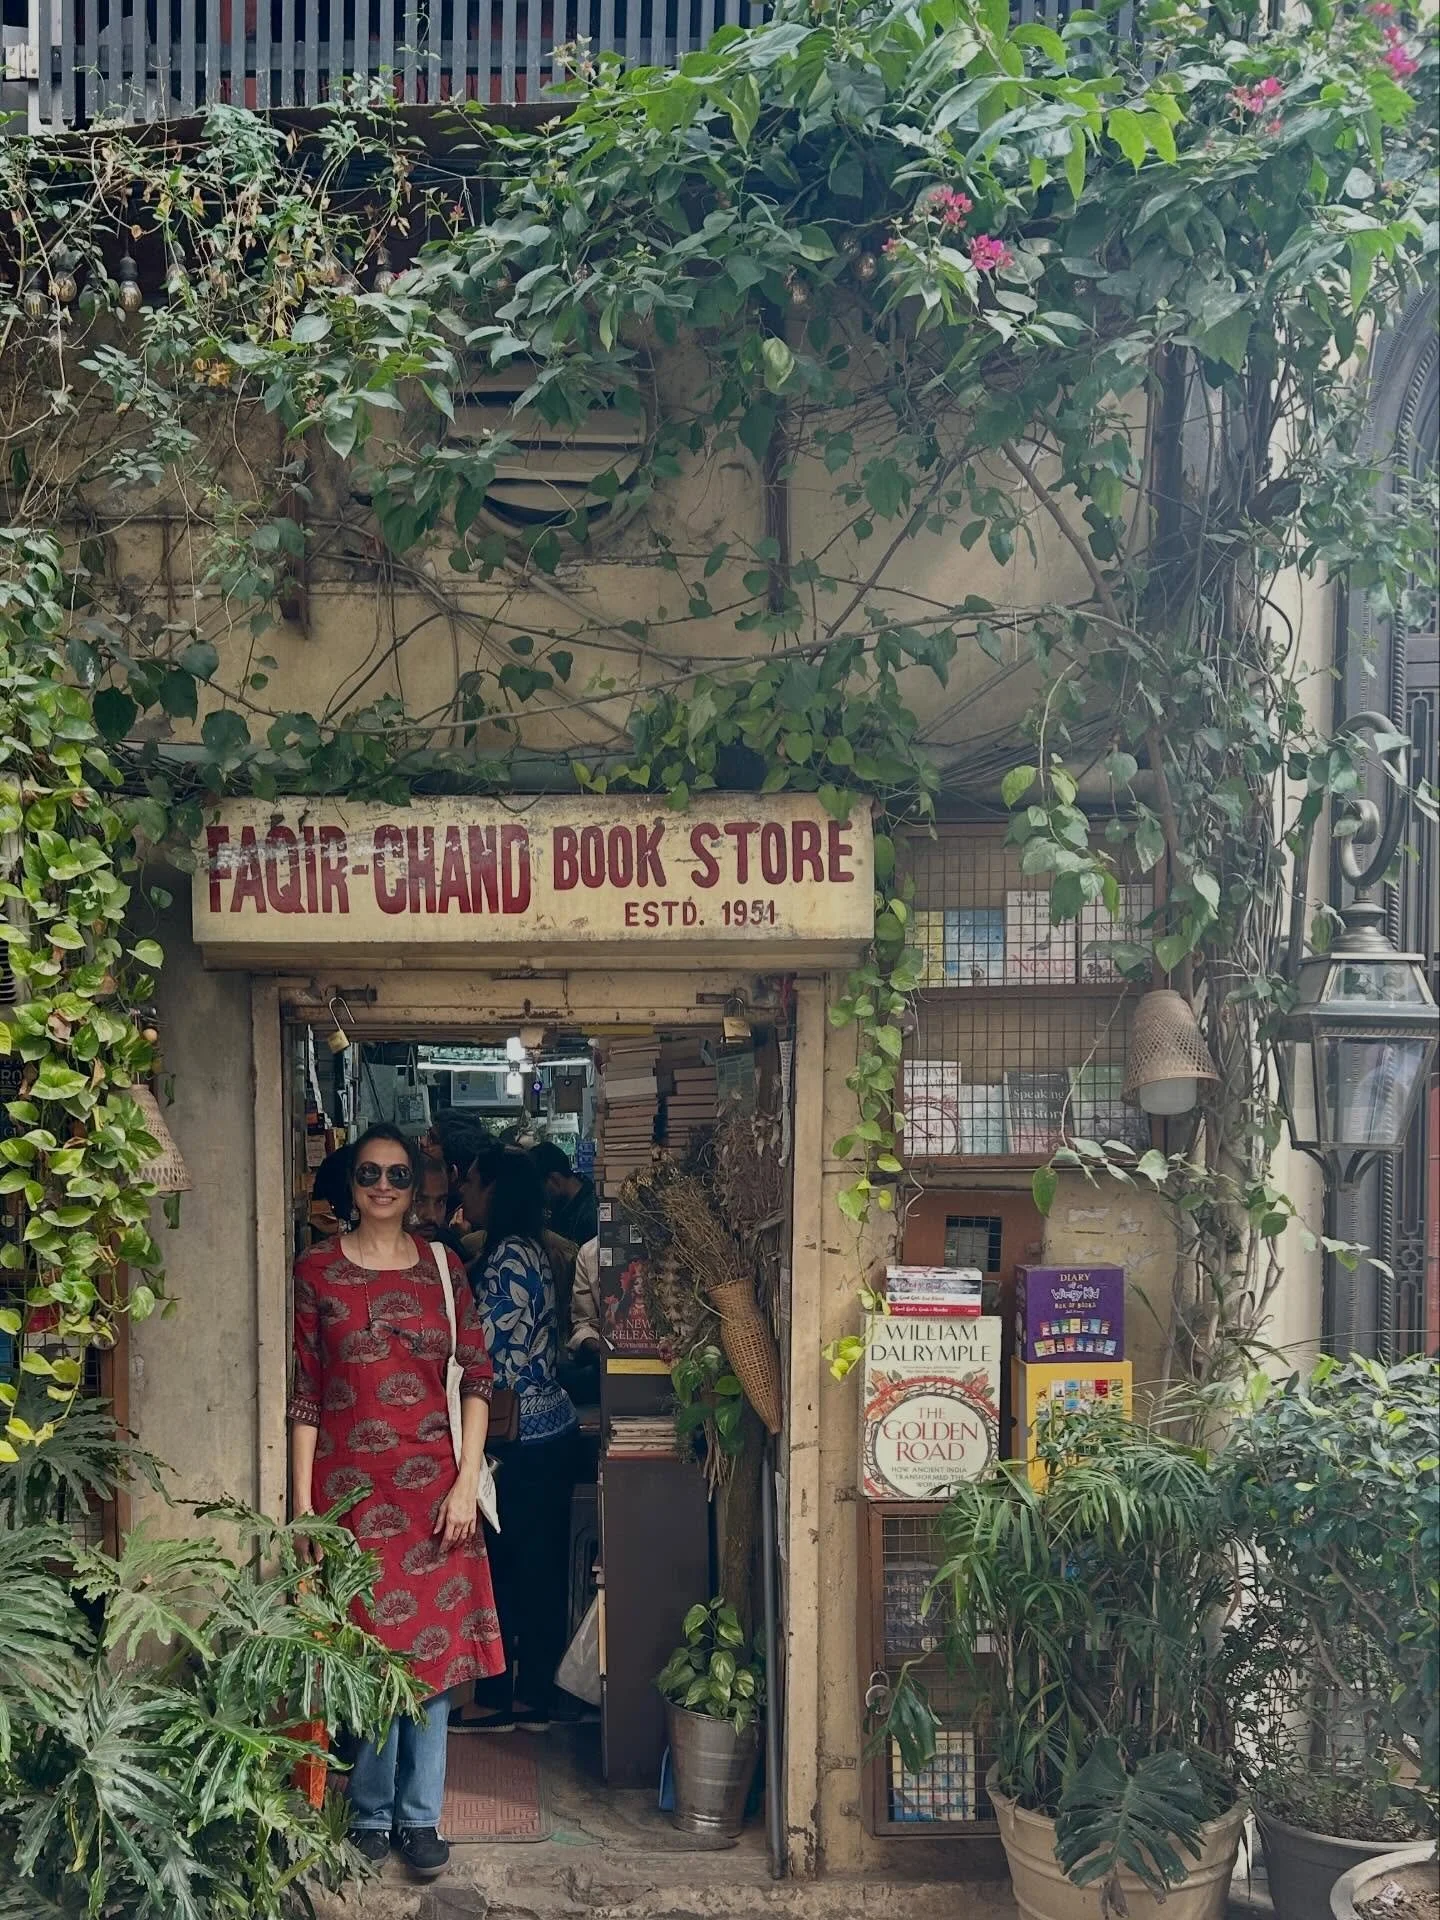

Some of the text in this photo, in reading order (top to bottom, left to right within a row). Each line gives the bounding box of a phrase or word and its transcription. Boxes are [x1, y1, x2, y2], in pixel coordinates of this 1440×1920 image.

[206, 818, 855, 915] FAQIR-CHAND BOOK STORE
[624, 900, 775, 928] ESTD. 1951
[1060, 1273, 1091, 1282] DIARY
[626, 1319, 653, 1329] NEW
[886, 1324, 978, 1341] WILLIAM
[871, 1344, 993, 1362] DALRYMPLE
[916, 1407, 946, 1419] THE
[883, 1421, 978, 1441] GOLDEN
[896, 1441, 965, 1463] ROAD
